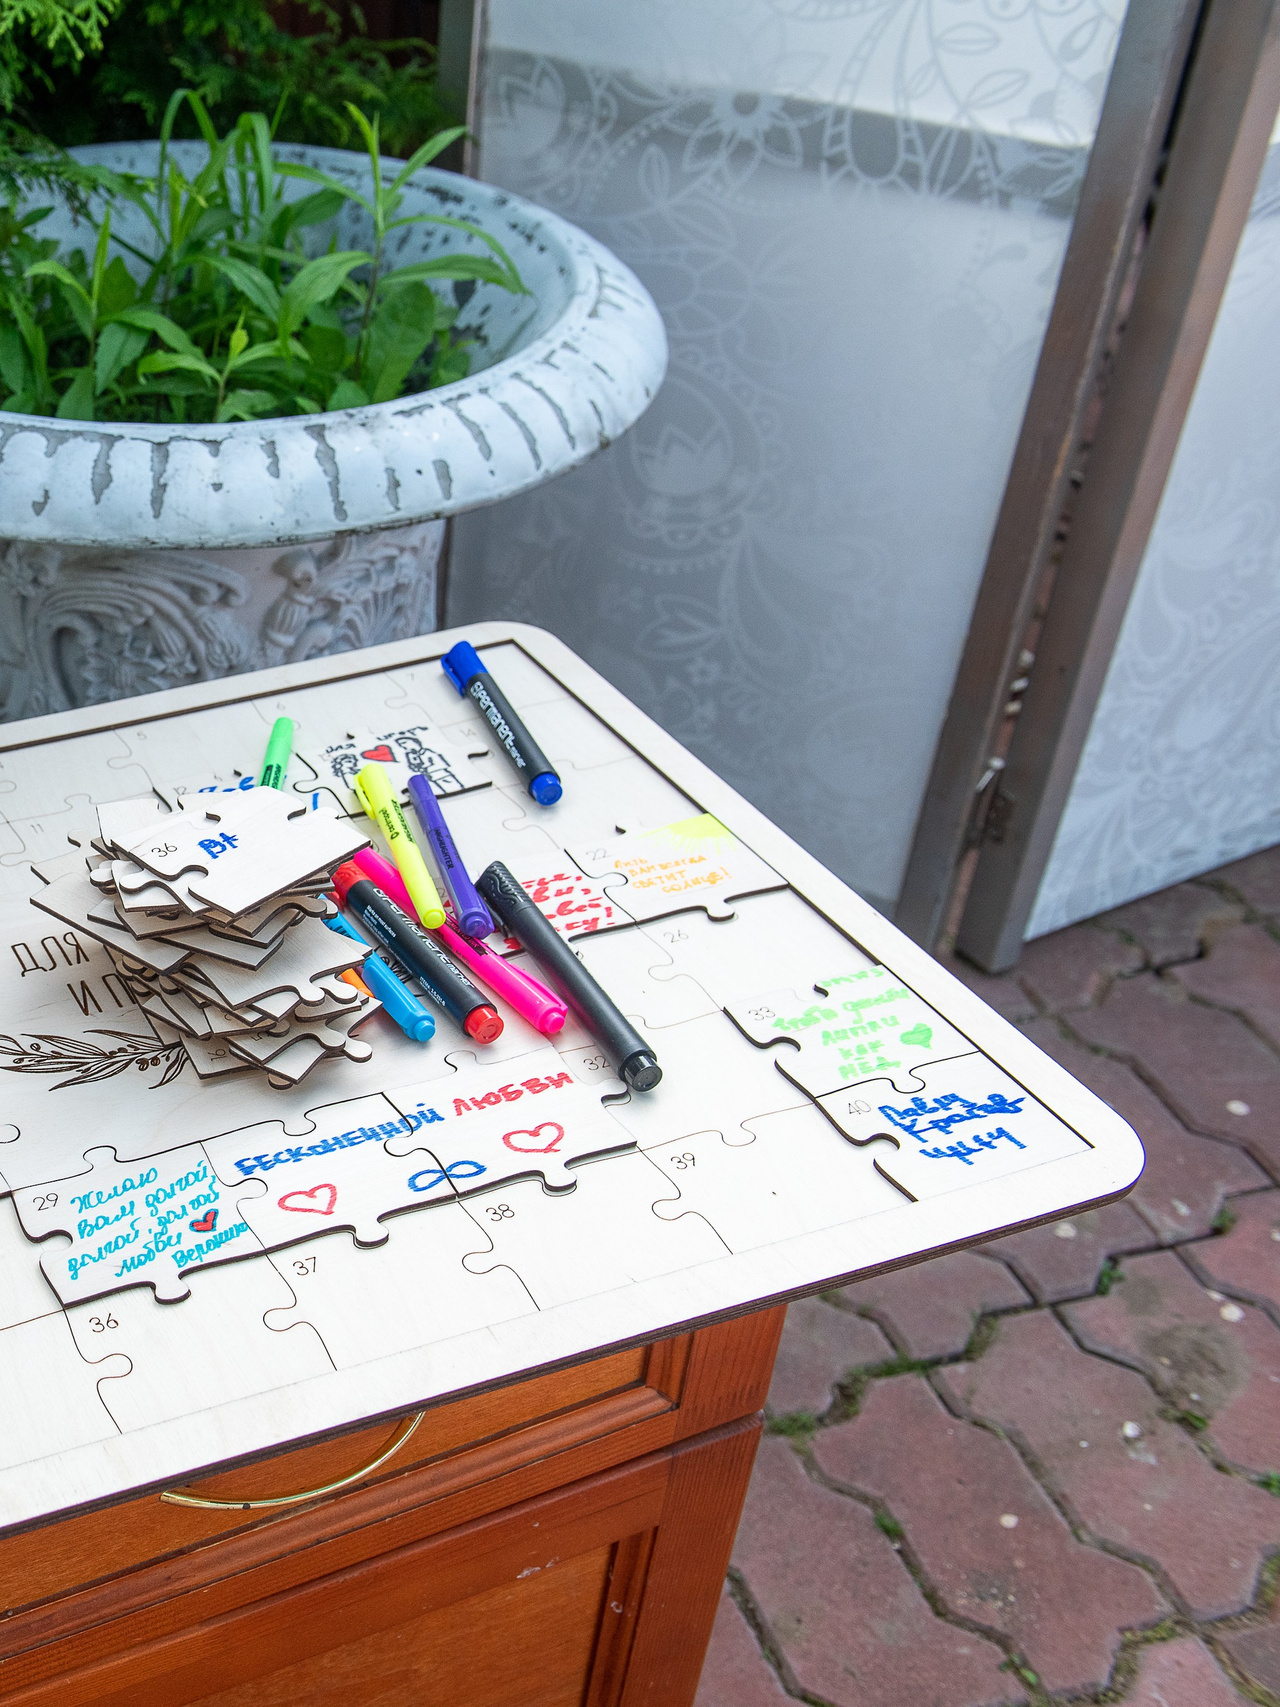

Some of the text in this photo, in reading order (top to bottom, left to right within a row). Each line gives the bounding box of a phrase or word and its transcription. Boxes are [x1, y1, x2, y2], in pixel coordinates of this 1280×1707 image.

[136, 731, 147, 741] 5
[151, 842, 178, 858] 36
[434, 828, 454, 870] HIGHLIGHTER
[586, 849, 612, 861] 22
[664, 930, 689, 943] 26
[11, 932, 90, 977] ДЛЯ
[66, 980, 103, 1016] И
[748, 1006, 776, 1021] 33
[583, 1055, 611, 1071] 32
[848, 1100, 872, 1115] 40
[233, 1071, 575, 1177] БЕСКОНЕЧНОЙ ЛЮБВИ
[670, 1152, 696, 1170] 39
[70, 1167, 158, 1214] Желаю
[32, 1192, 59, 1211] 29
[485, 1203, 516, 1222] 38
[292, 1256, 318, 1276] 37
[89, 1312, 119, 1333] 36
